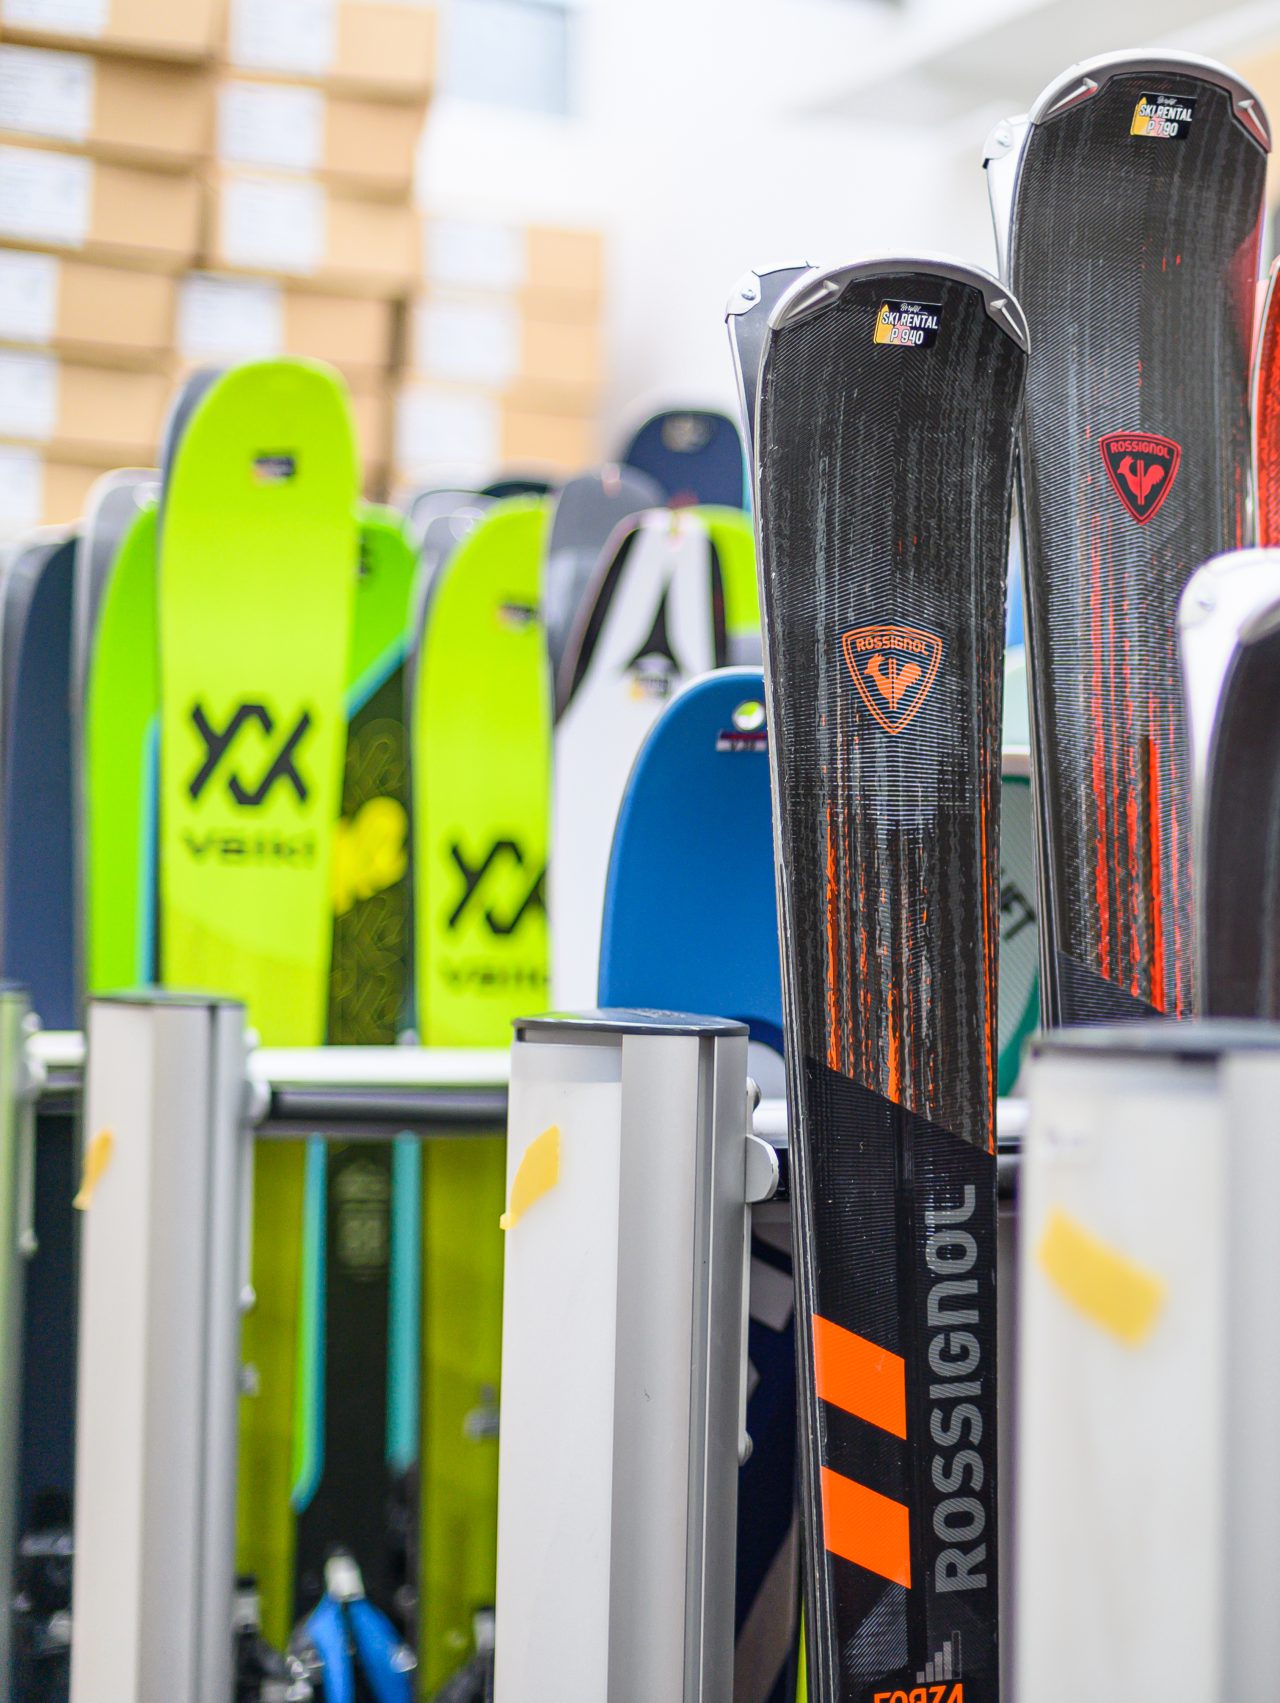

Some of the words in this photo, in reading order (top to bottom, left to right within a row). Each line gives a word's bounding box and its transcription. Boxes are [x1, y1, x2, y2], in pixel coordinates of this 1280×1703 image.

[1139, 104, 1156, 117] SKI
[1157, 105, 1193, 122] RENTAL
[1147, 120, 1156, 134] P
[1158, 121, 1179, 137] 790
[882, 311, 900, 326] SKI
[900, 313, 939, 330] RENTAL
[890, 328, 900, 343] P
[901, 329, 925, 345] 940
[1109, 440, 1171, 460] ROSSIGNOL
[855, 635, 929, 656] ROSSIGNOL
[922, 1184, 988, 1594] ROSSIGNOL
